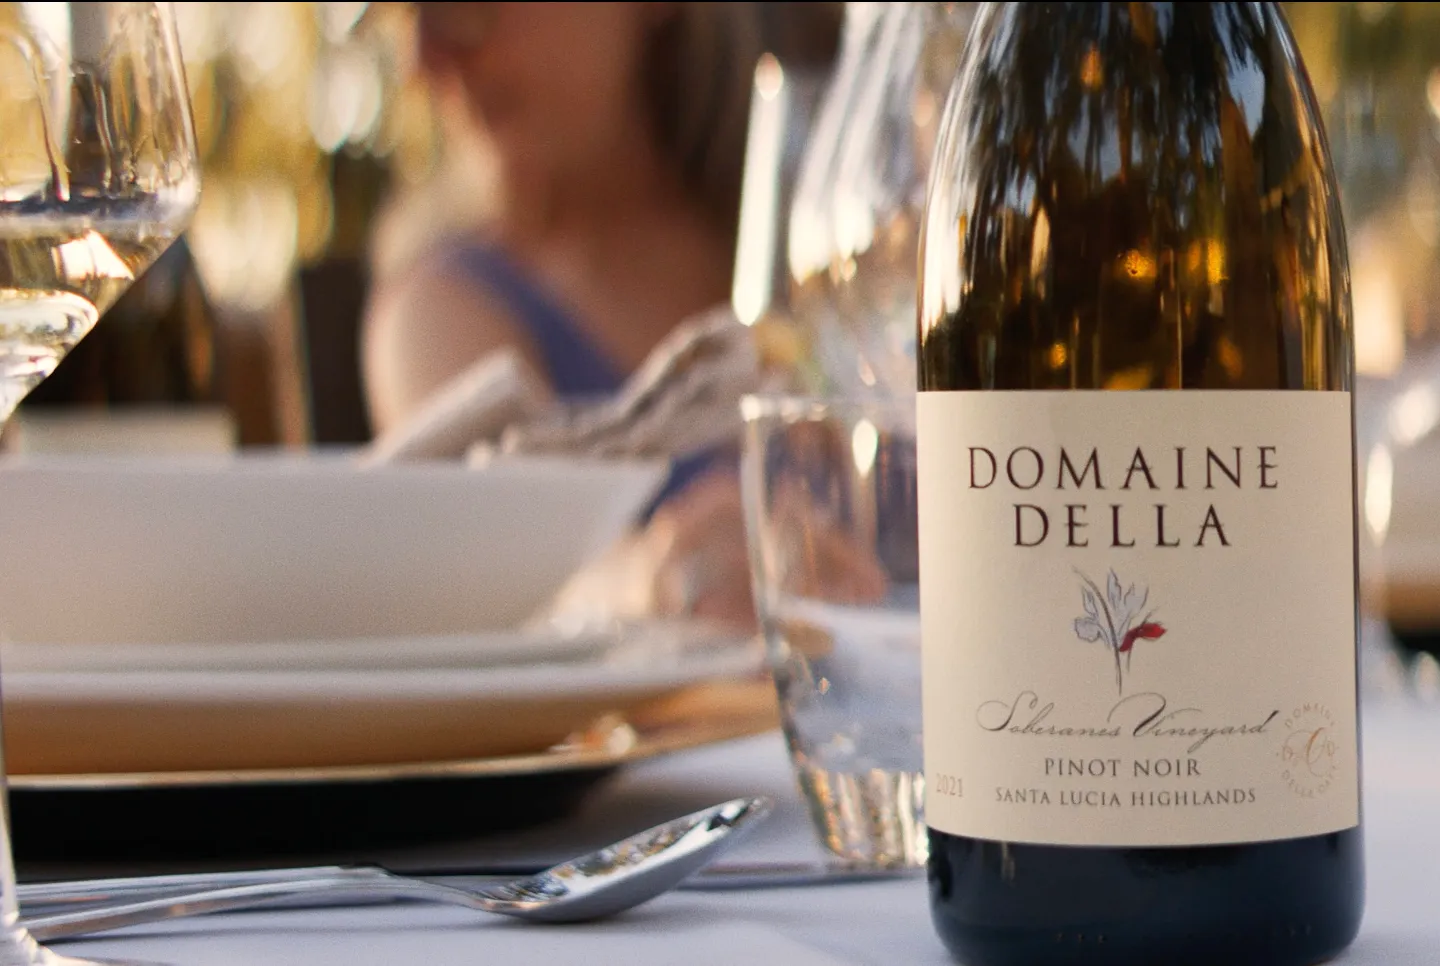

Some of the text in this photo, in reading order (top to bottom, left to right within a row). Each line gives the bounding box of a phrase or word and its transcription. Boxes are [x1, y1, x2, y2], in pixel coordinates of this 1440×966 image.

[967, 445, 1280, 491] DOMAINE
[1013, 503, 1232, 548] DELLA
[975, 690, 1281, 754] Soberanes Vineyard
[1044, 757, 1203, 777] PINOT NOIR
[935, 772, 964, 798] 2021
[994, 787, 1257, 807] SANTA LUCIA HIGHLANDS
